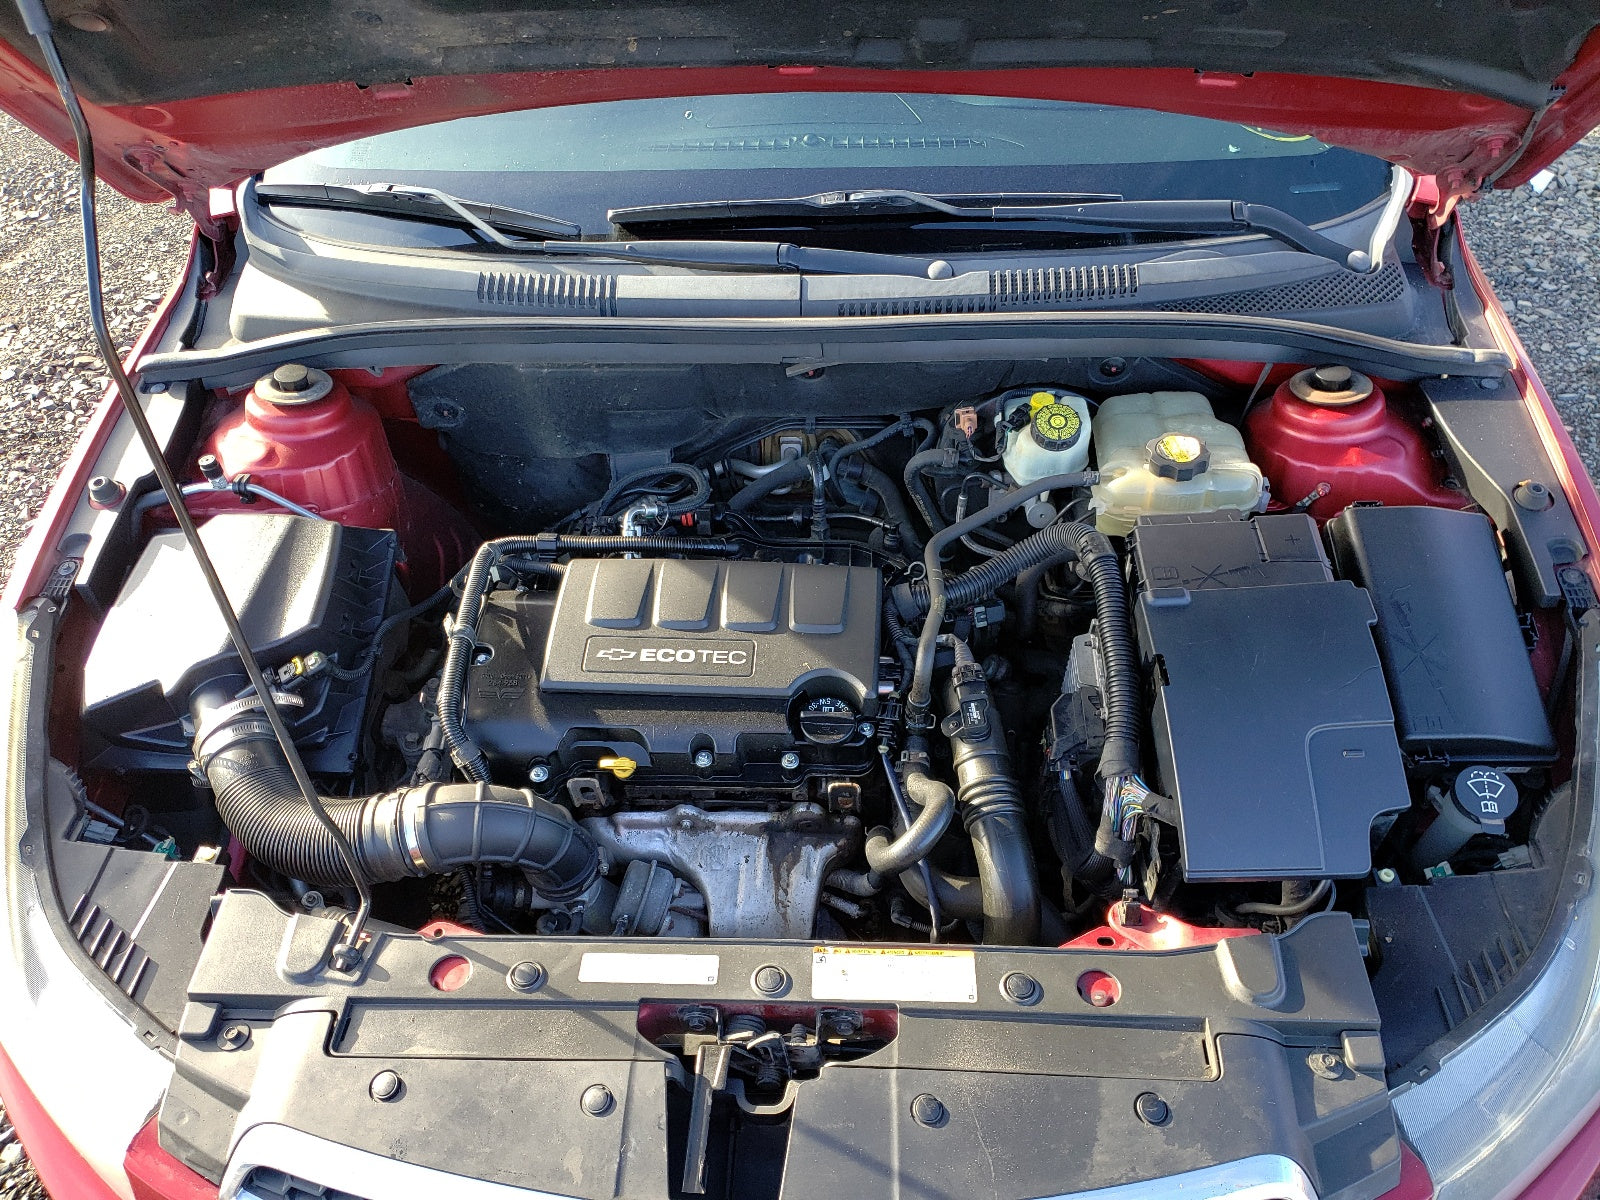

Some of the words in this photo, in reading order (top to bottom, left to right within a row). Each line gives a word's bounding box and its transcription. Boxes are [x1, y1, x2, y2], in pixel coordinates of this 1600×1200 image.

[640, 648, 747, 664] ECOTEC
[808, 697, 832, 711] 5W-30
[835, 699, 849, 712] SAE
